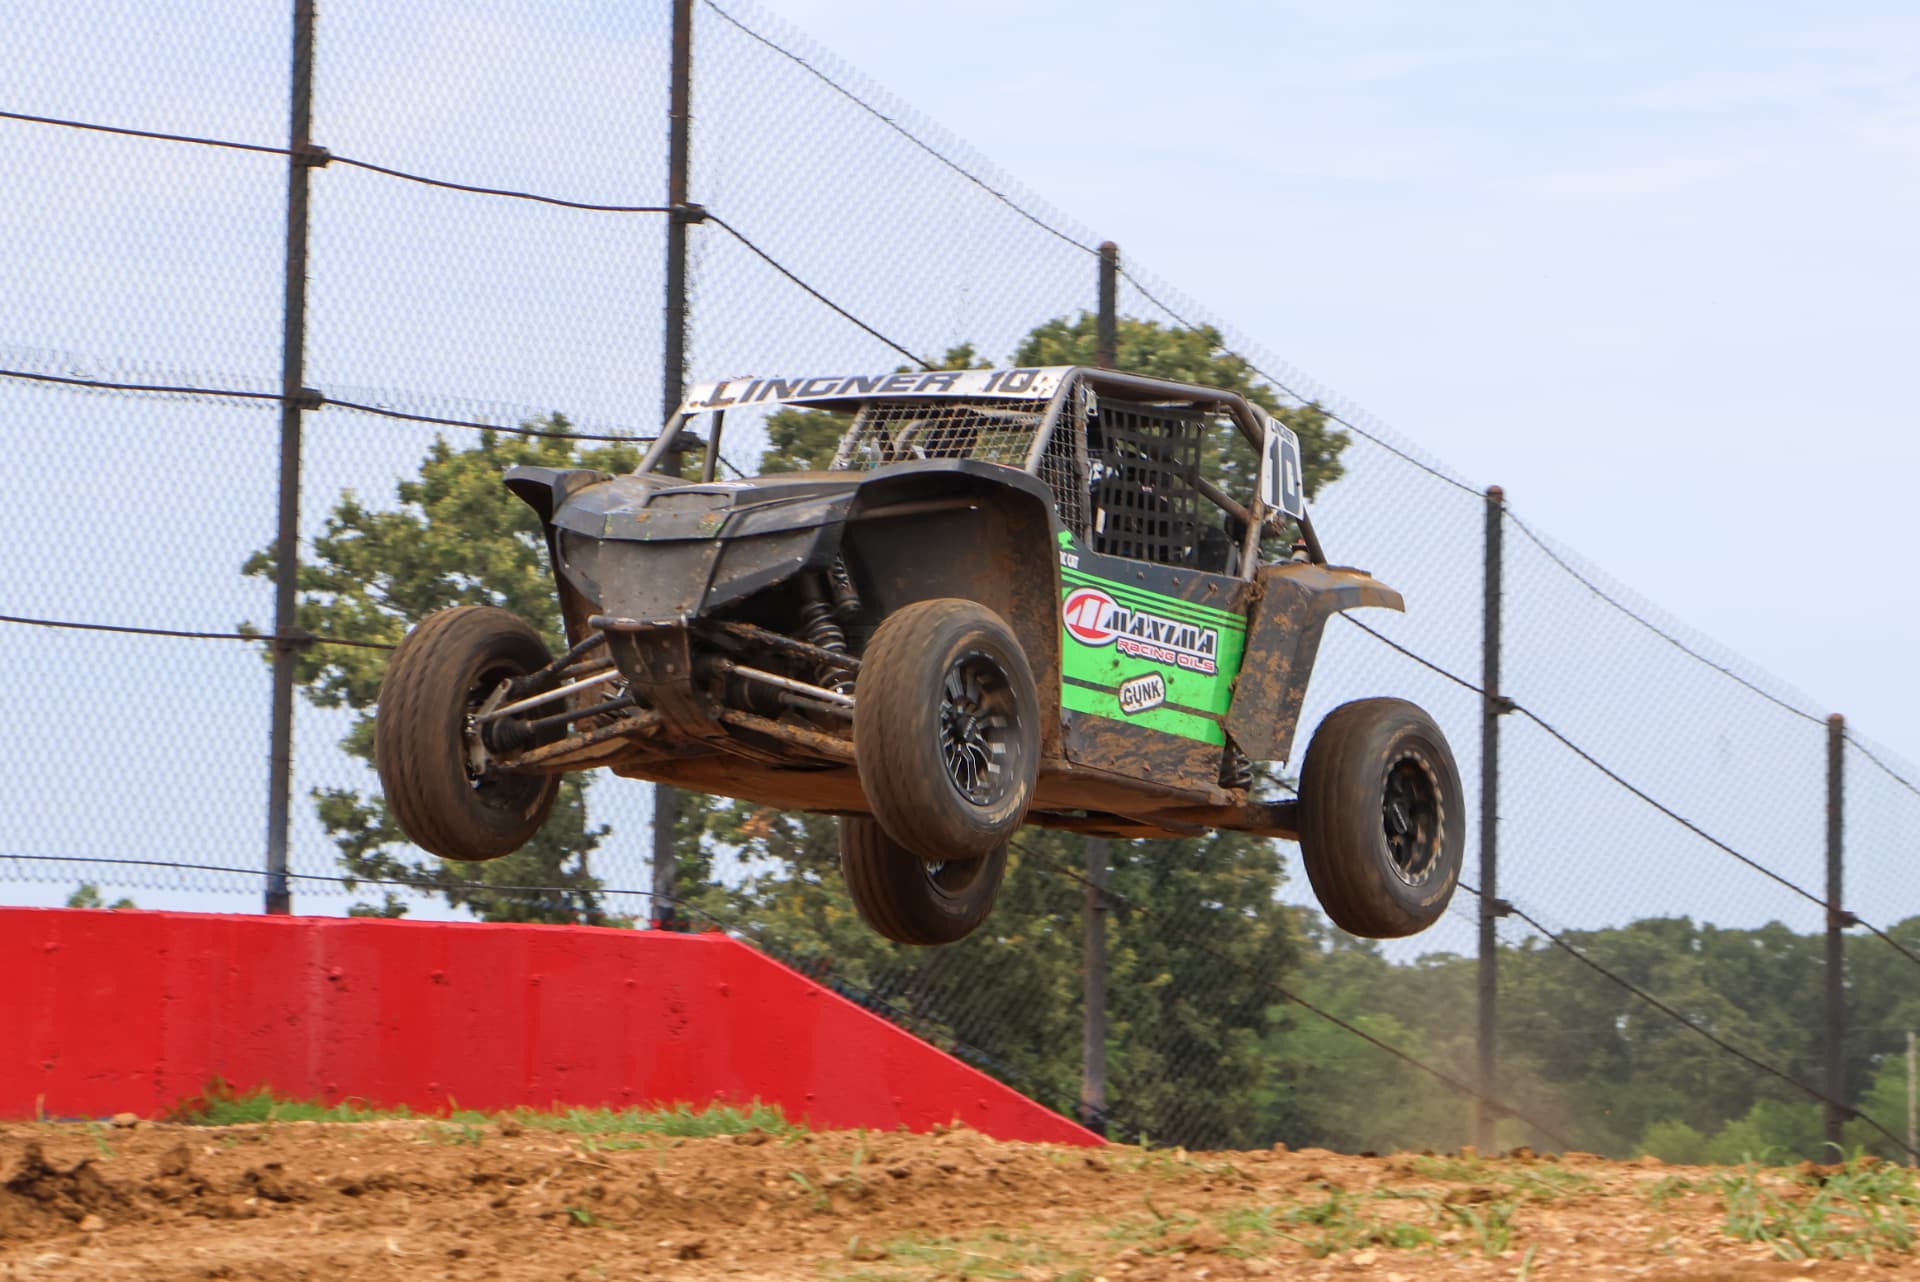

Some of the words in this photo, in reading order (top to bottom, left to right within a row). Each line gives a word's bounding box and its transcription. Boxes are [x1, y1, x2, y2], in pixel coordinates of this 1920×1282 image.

[700, 372, 964, 408] LINGNER
[982, 369, 1041, 393] 10
[1270, 435, 1301, 515] 10
[1103, 610, 1214, 655] MAXIMA
[1178, 656, 1215, 672] OILS
[1123, 680, 1161, 707] GUNK
